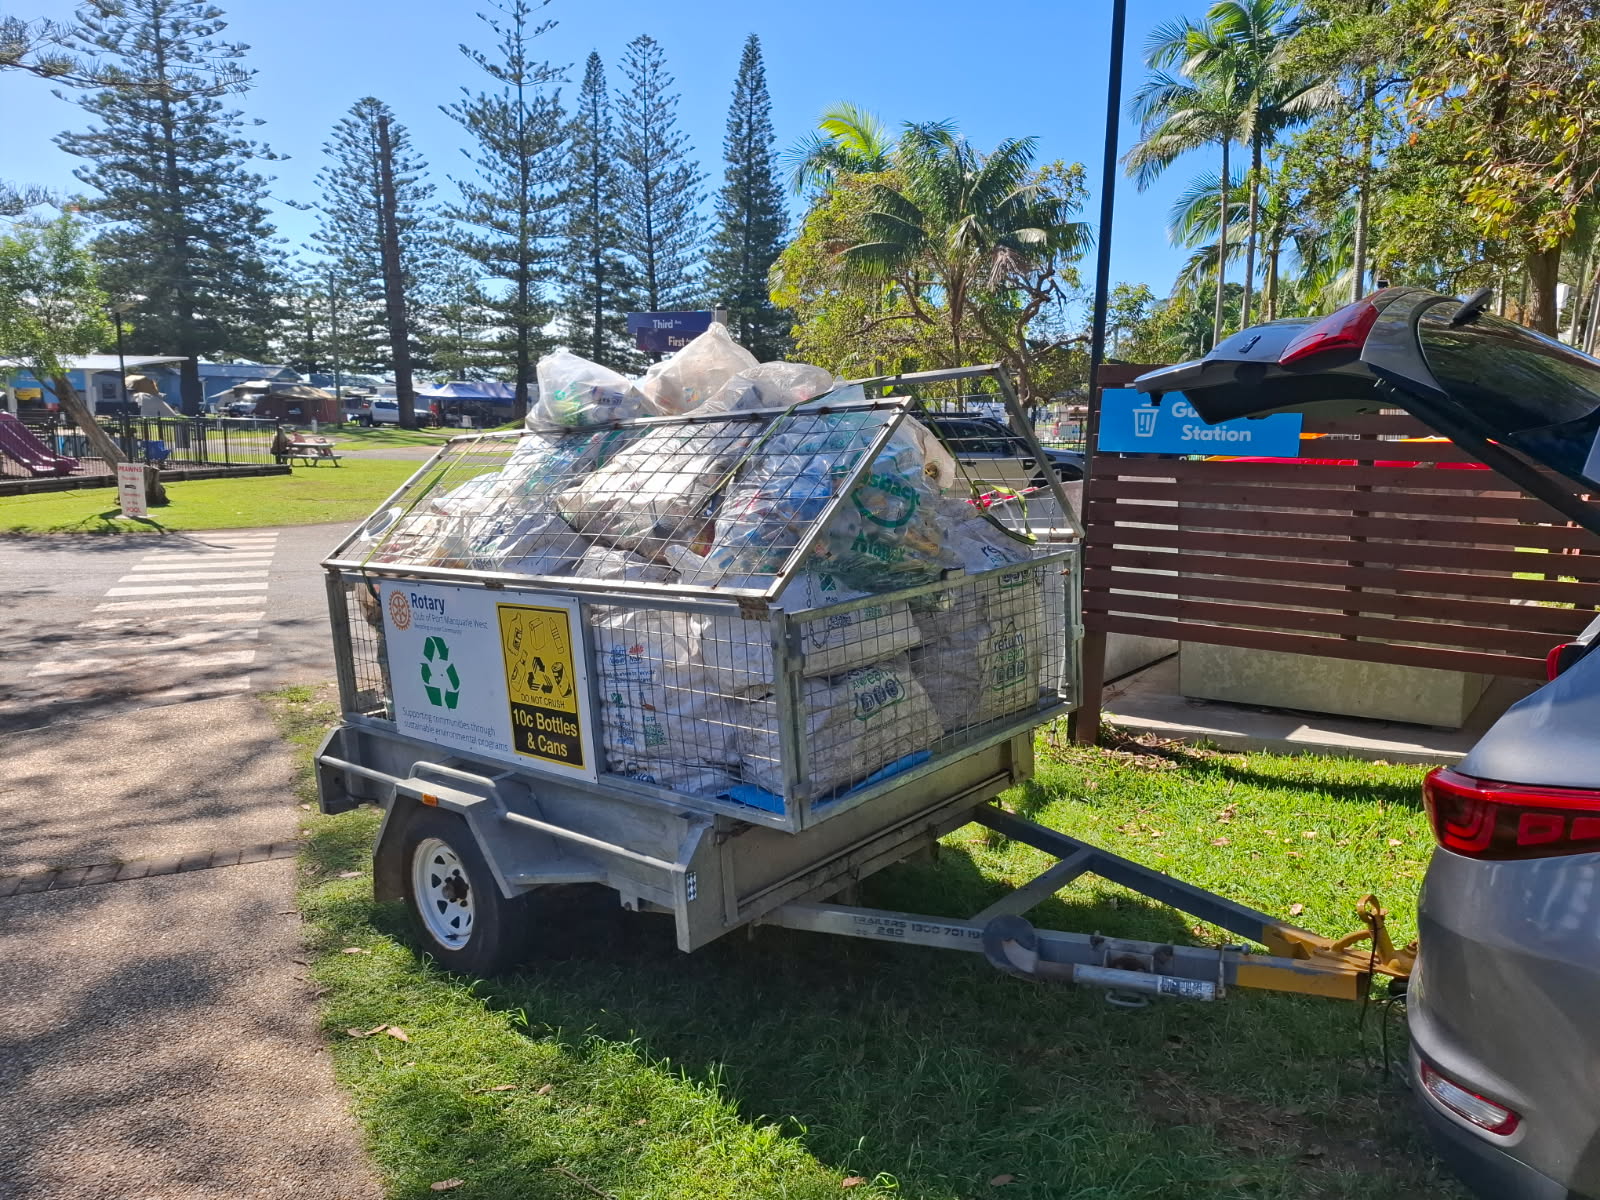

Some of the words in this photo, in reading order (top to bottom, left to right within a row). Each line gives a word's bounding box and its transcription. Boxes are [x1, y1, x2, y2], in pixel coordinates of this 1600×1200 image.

[652, 319, 673, 328] Third
[668, 335, 685, 346] First
[1181, 424, 1251, 441] Station
[411, 593, 445, 615] Rotary
[413, 611, 425, 621] Club
[474, 618, 489, 629] West
[993, 632, 1024, 652] return
[521, 693, 529, 702] DO
[531, 695, 542, 704] NOT
[544, 697, 565, 708] CRUSH
[402, 707, 433, 723] Supporting
[433, 715, 470, 730] communities
[470, 722, 495, 737] through
[513, 708, 534, 727] 10c
[536, 712, 578, 737] Bottles
[404, 721, 435, 734] sustainable
[435, 729, 477, 744] environmental
[478, 738, 509, 752] programs
[527, 732, 536, 750] &
[538, 735, 568, 757] Cans
[854, 916, 907, 928] TRAILERS
[911, 923, 940, 934] 1300
[944, 927, 964, 937] 701
